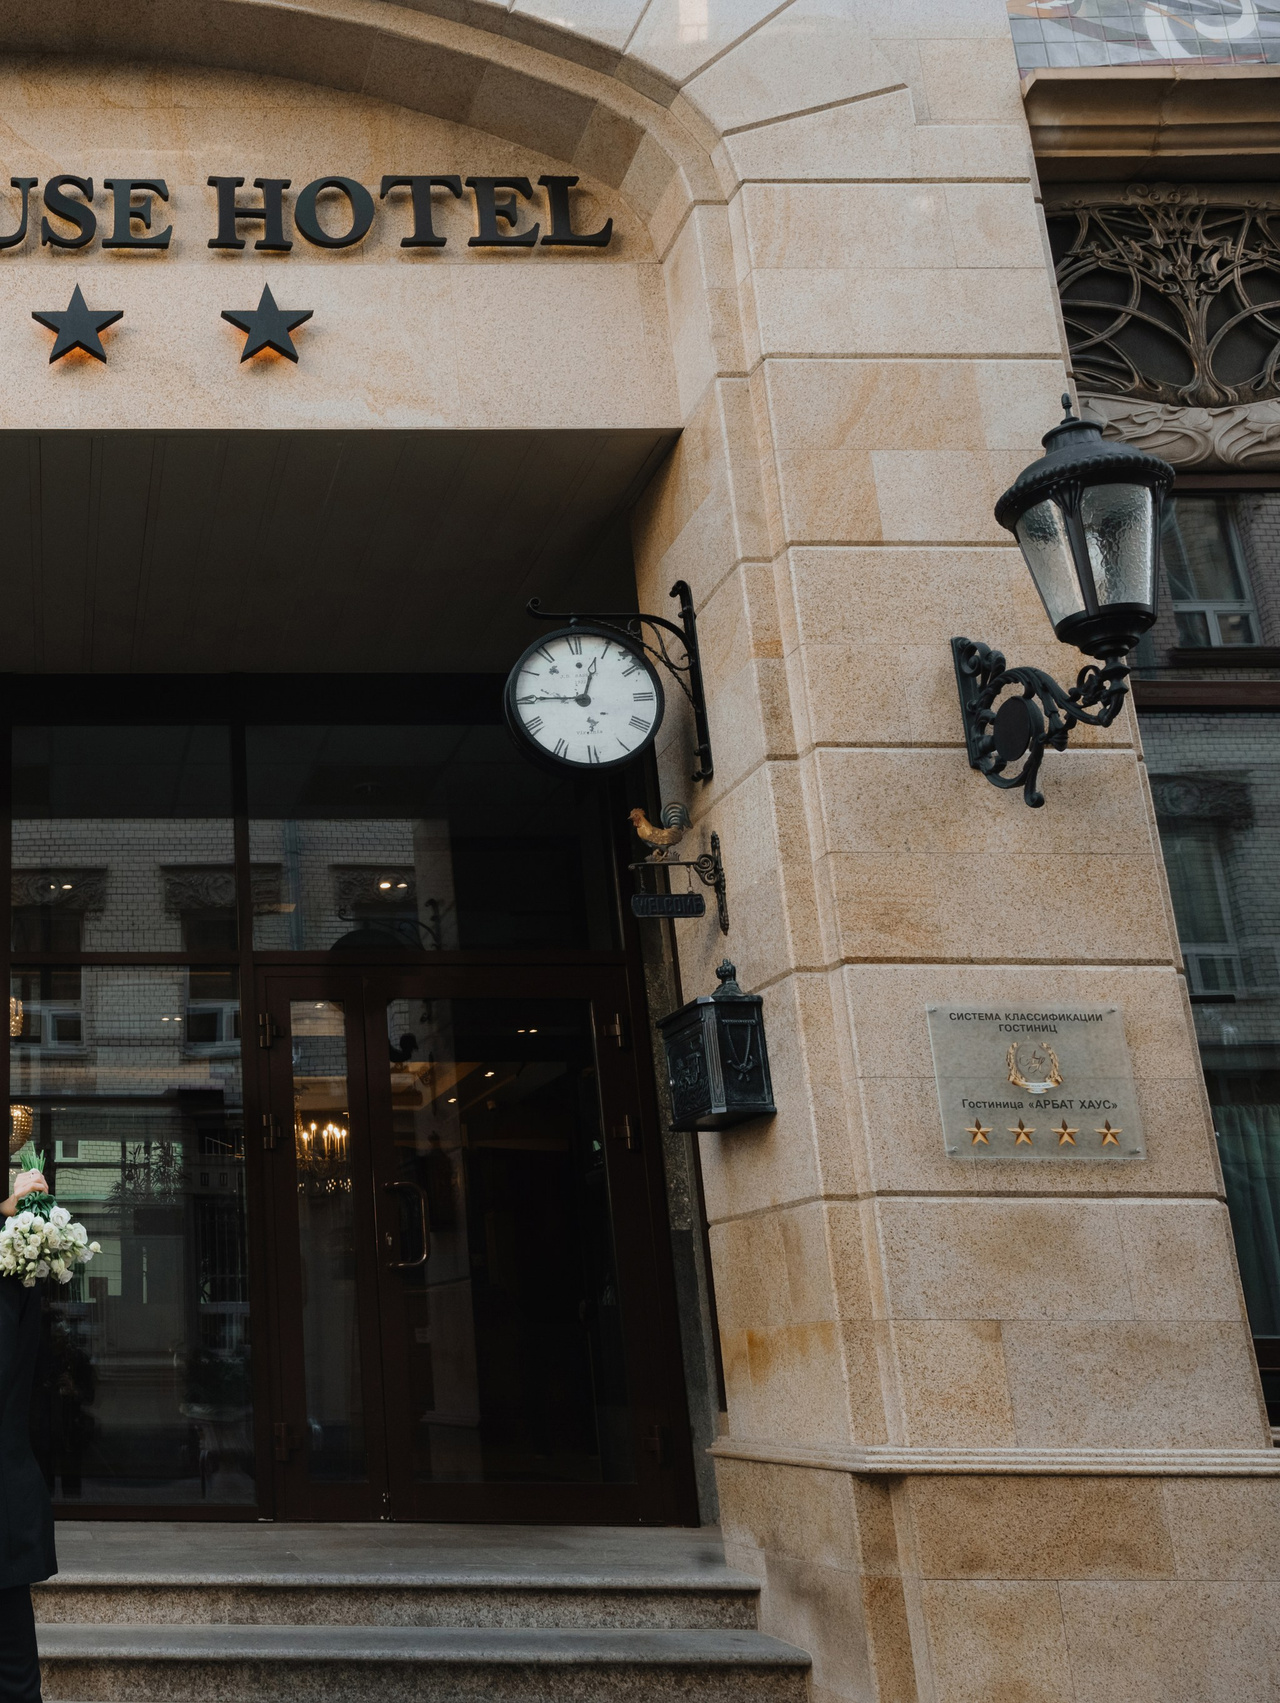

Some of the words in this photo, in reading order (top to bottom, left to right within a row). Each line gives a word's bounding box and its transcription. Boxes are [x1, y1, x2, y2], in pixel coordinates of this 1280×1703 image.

[207, 175, 613, 251] HOTEL
[634, 896, 703, 915] WELCOME
[949, 1012, 1001, 1021] СИСТЕМА
[1005, 1012, 1103, 1022] КЛАССИФИКАЦИИ
[998, 1024, 1057, 1033] ГОСТИНИЦ
[962, 1098, 1024, 1110] Гостиница
[1028, 1099, 1074, 1110] «АРБАТ
[1079, 1099, 1118, 1110] ХАУС»
